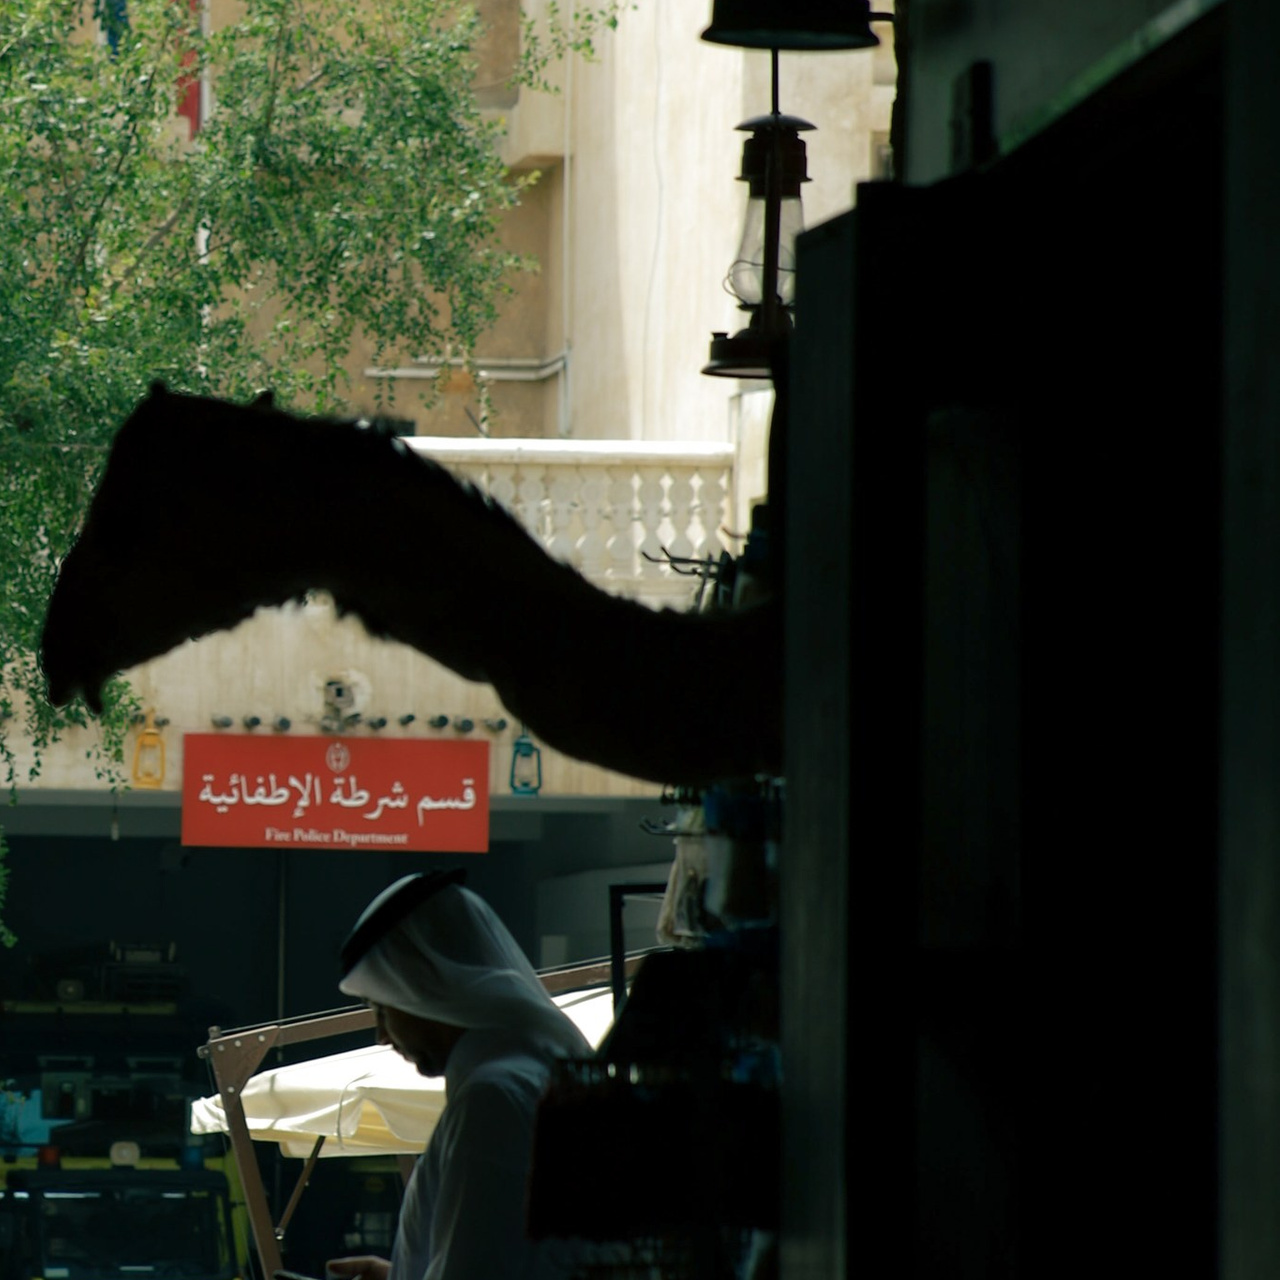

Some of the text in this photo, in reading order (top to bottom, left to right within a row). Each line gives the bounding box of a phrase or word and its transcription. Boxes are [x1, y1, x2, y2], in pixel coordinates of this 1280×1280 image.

[198, 772, 477, 826] قسم شرطة الإطفائية
[264, 826, 409, 847] Fire Police Department
